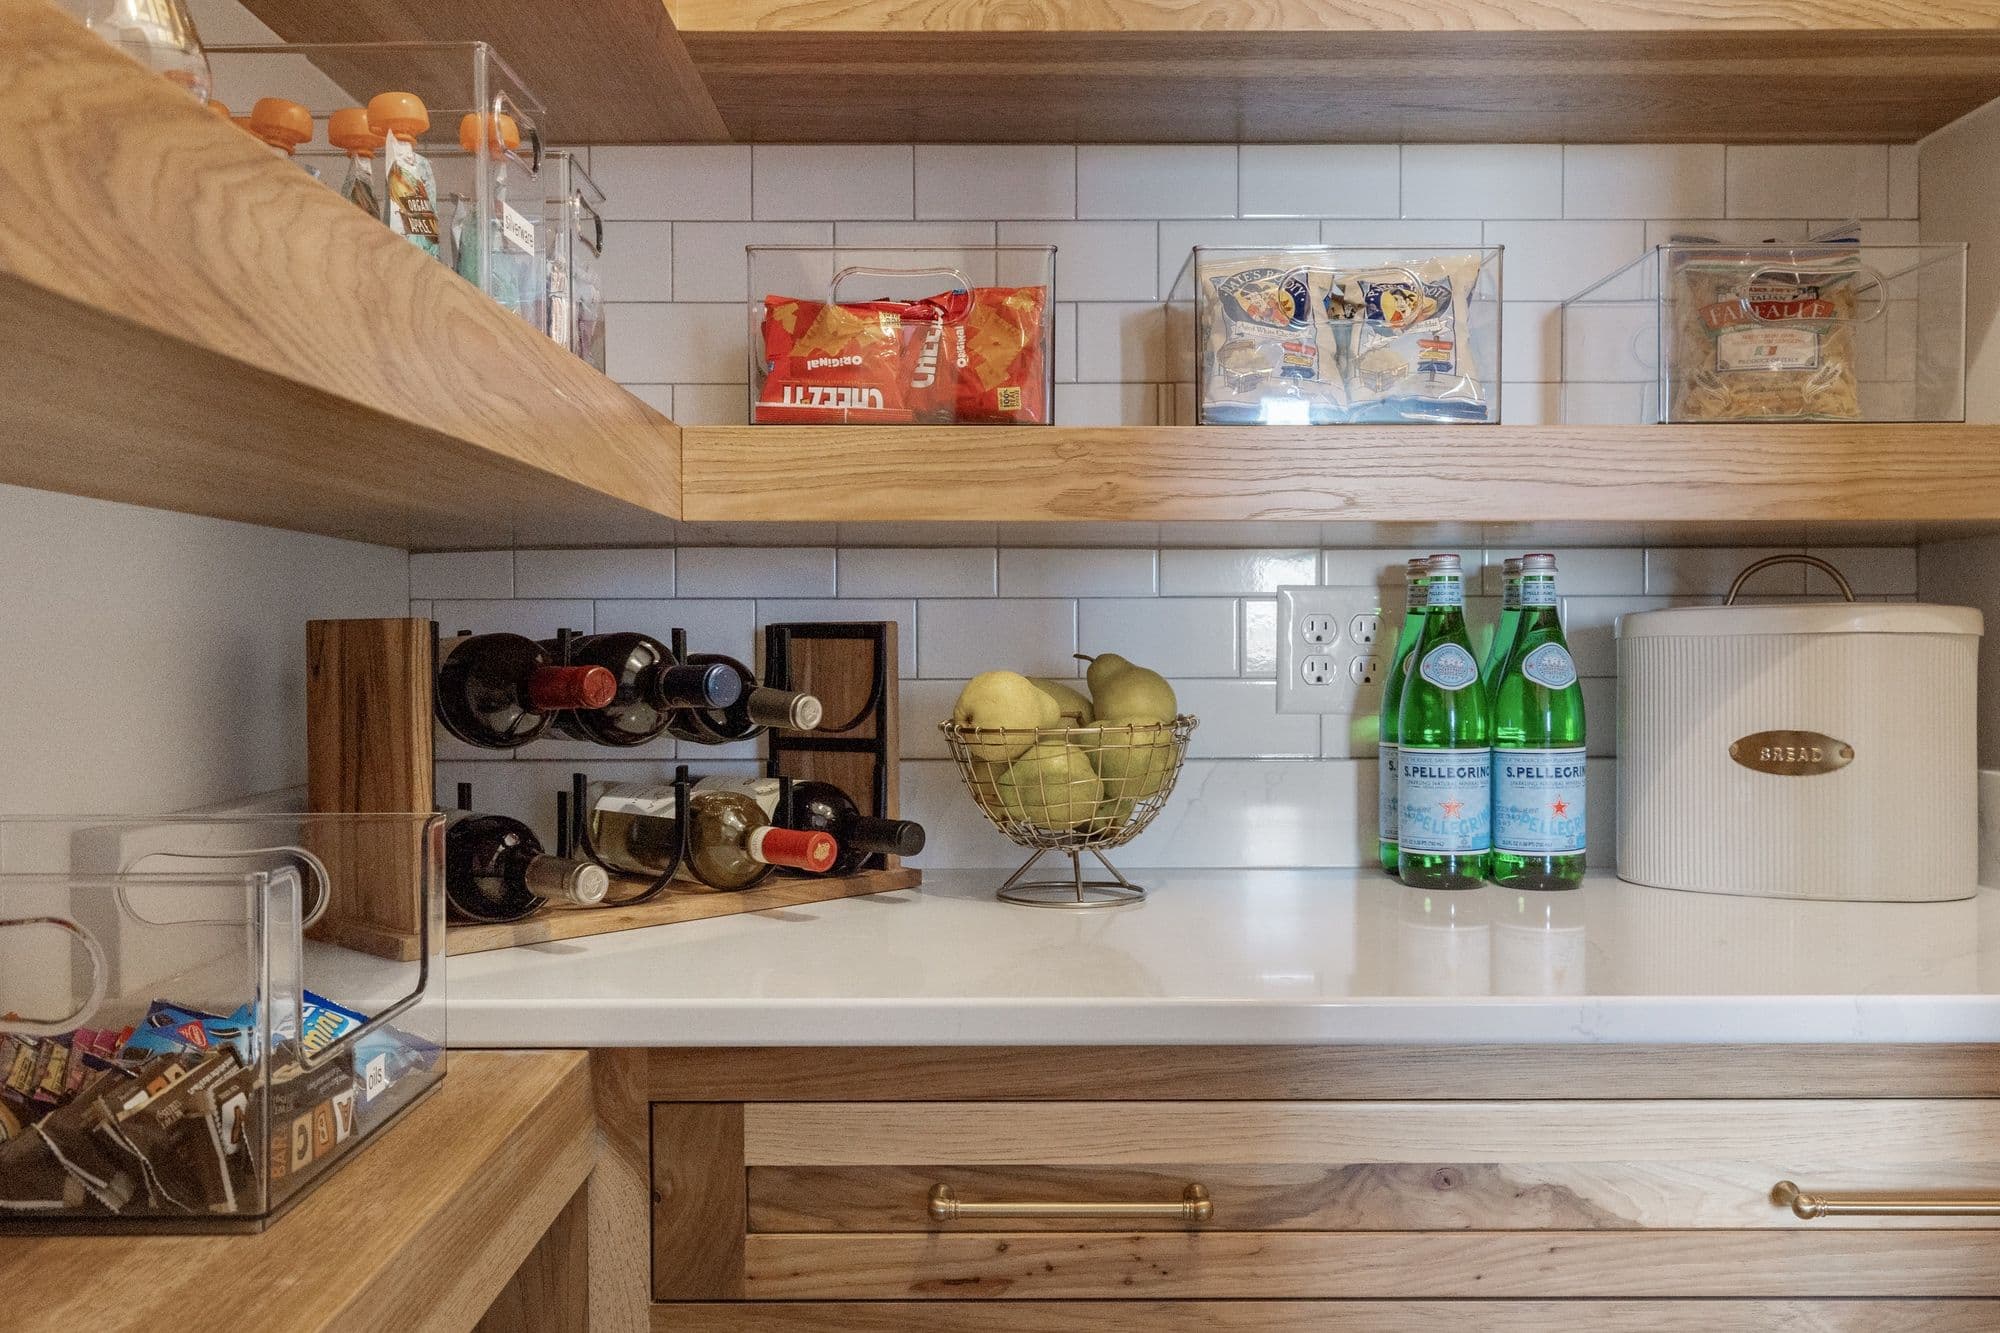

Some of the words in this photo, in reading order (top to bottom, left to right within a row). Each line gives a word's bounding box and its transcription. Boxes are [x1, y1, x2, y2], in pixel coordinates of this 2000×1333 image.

[1760, 747, 1823, 762] BREAD
[303, 1008, 343, 1058] mini
[368, 1066, 383, 1090] oils
